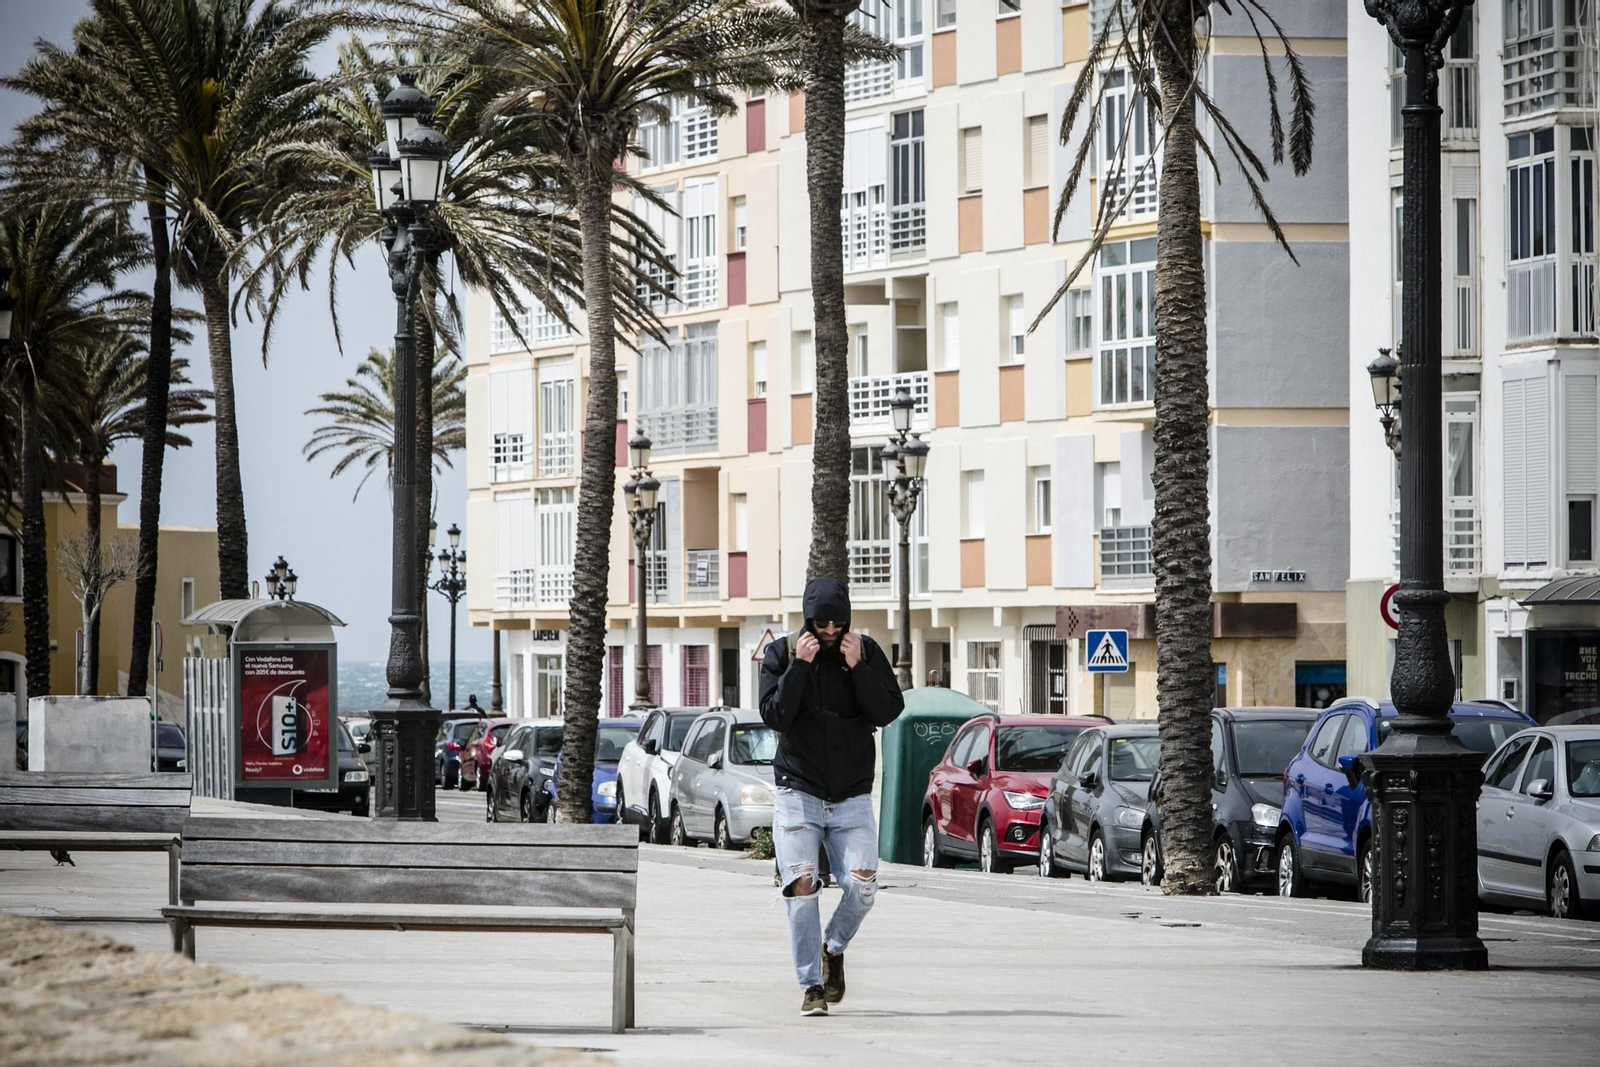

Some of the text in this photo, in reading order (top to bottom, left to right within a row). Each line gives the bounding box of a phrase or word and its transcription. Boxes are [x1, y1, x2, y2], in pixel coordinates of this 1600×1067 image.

[1253, 572, 1271, 581] SAN
[1581, 655, 1597, 663] VOY
[1586, 663, 1597, 672] AL
[1565, 671, 1597, 680] TRECHO
[281, 702, 297, 751] S10+
